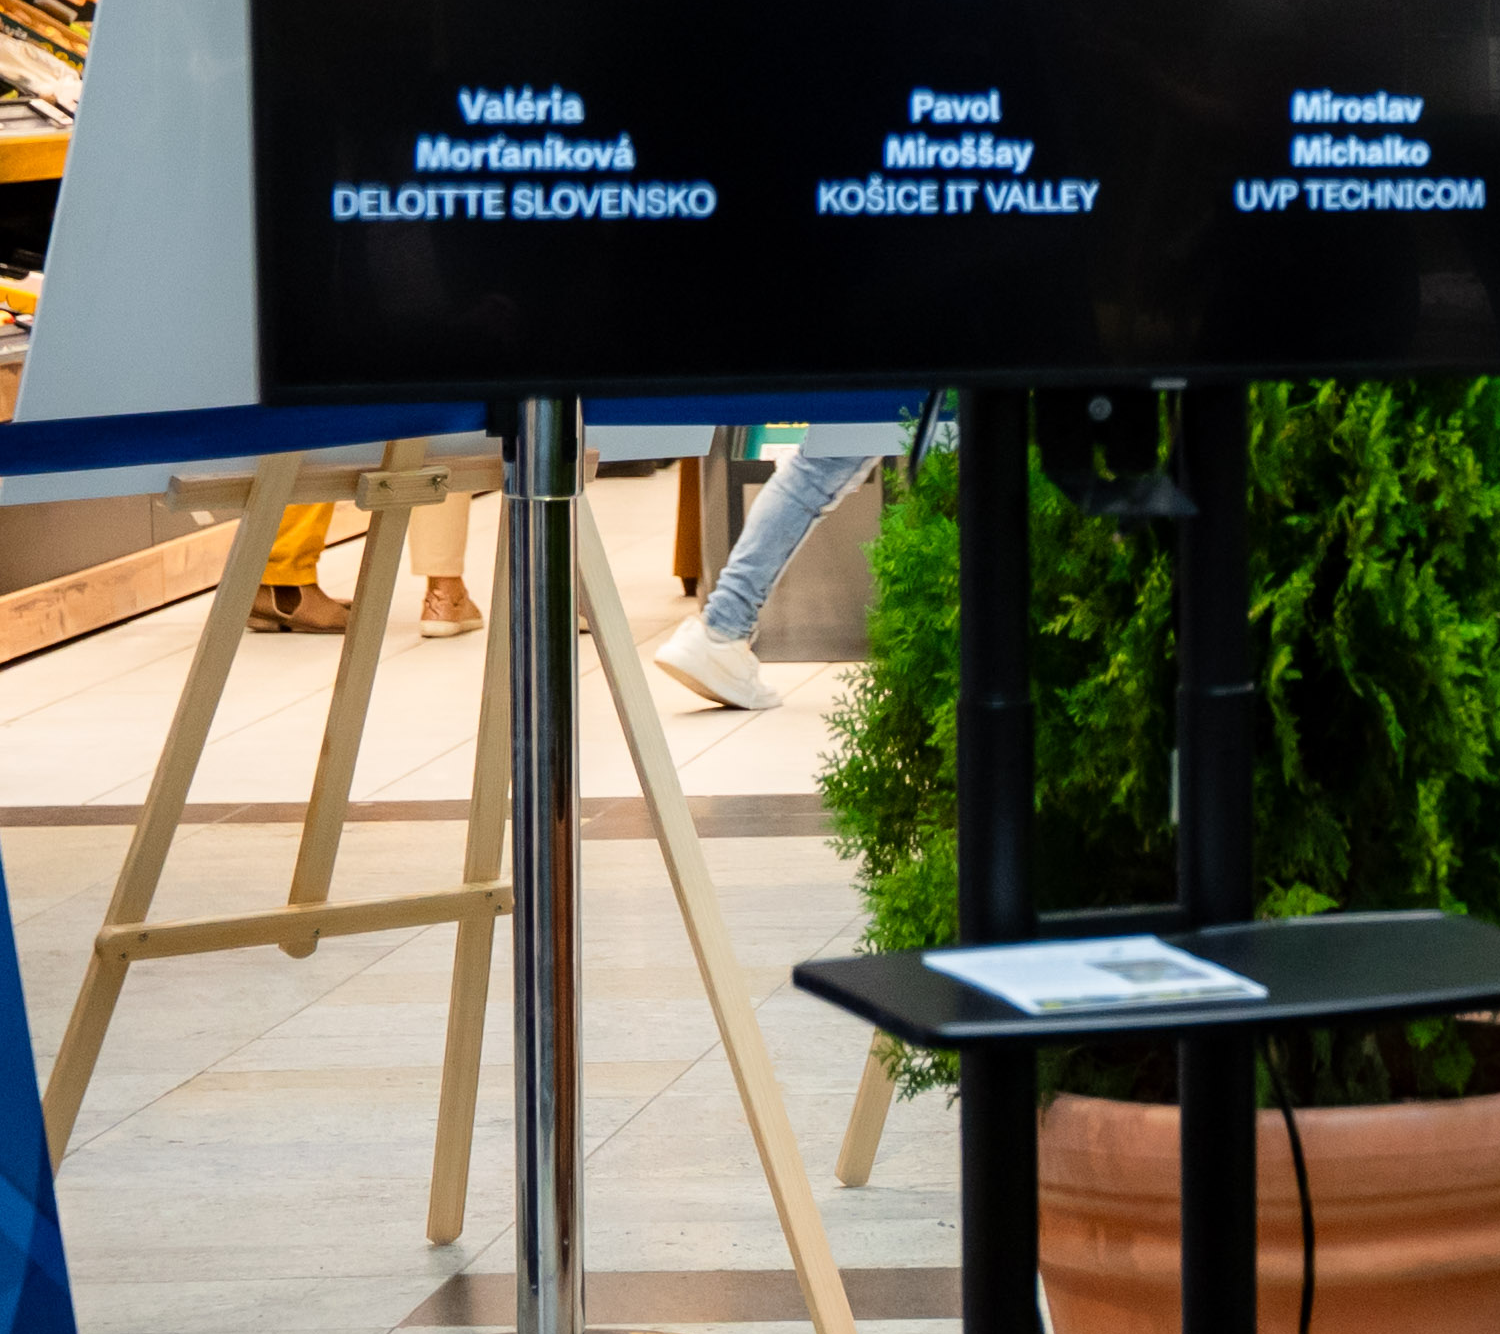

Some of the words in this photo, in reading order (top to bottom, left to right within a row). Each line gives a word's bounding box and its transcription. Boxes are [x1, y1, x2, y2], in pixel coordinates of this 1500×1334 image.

[459, 86, 585, 124] Valéria
[911, 89, 1001, 123] Pavol
[1292, 89, 1424, 123] Miroslav
[416, 133, 635, 171] Morťaníková
[885, 133, 1034, 174] Miroššay
[1292, 134, 1431, 167] Michalko
[333, 182, 506, 220] DELOITTE
[511, 182, 717, 219] SLOVENSKO
[818, 174, 939, 214] KOŠICE
[945, 180, 980, 214] IT
[984, 180, 1100, 213] VALLEY
[1235, 179, 1299, 211] UVP
[1303, 179, 1486, 210] TECHNICOM
